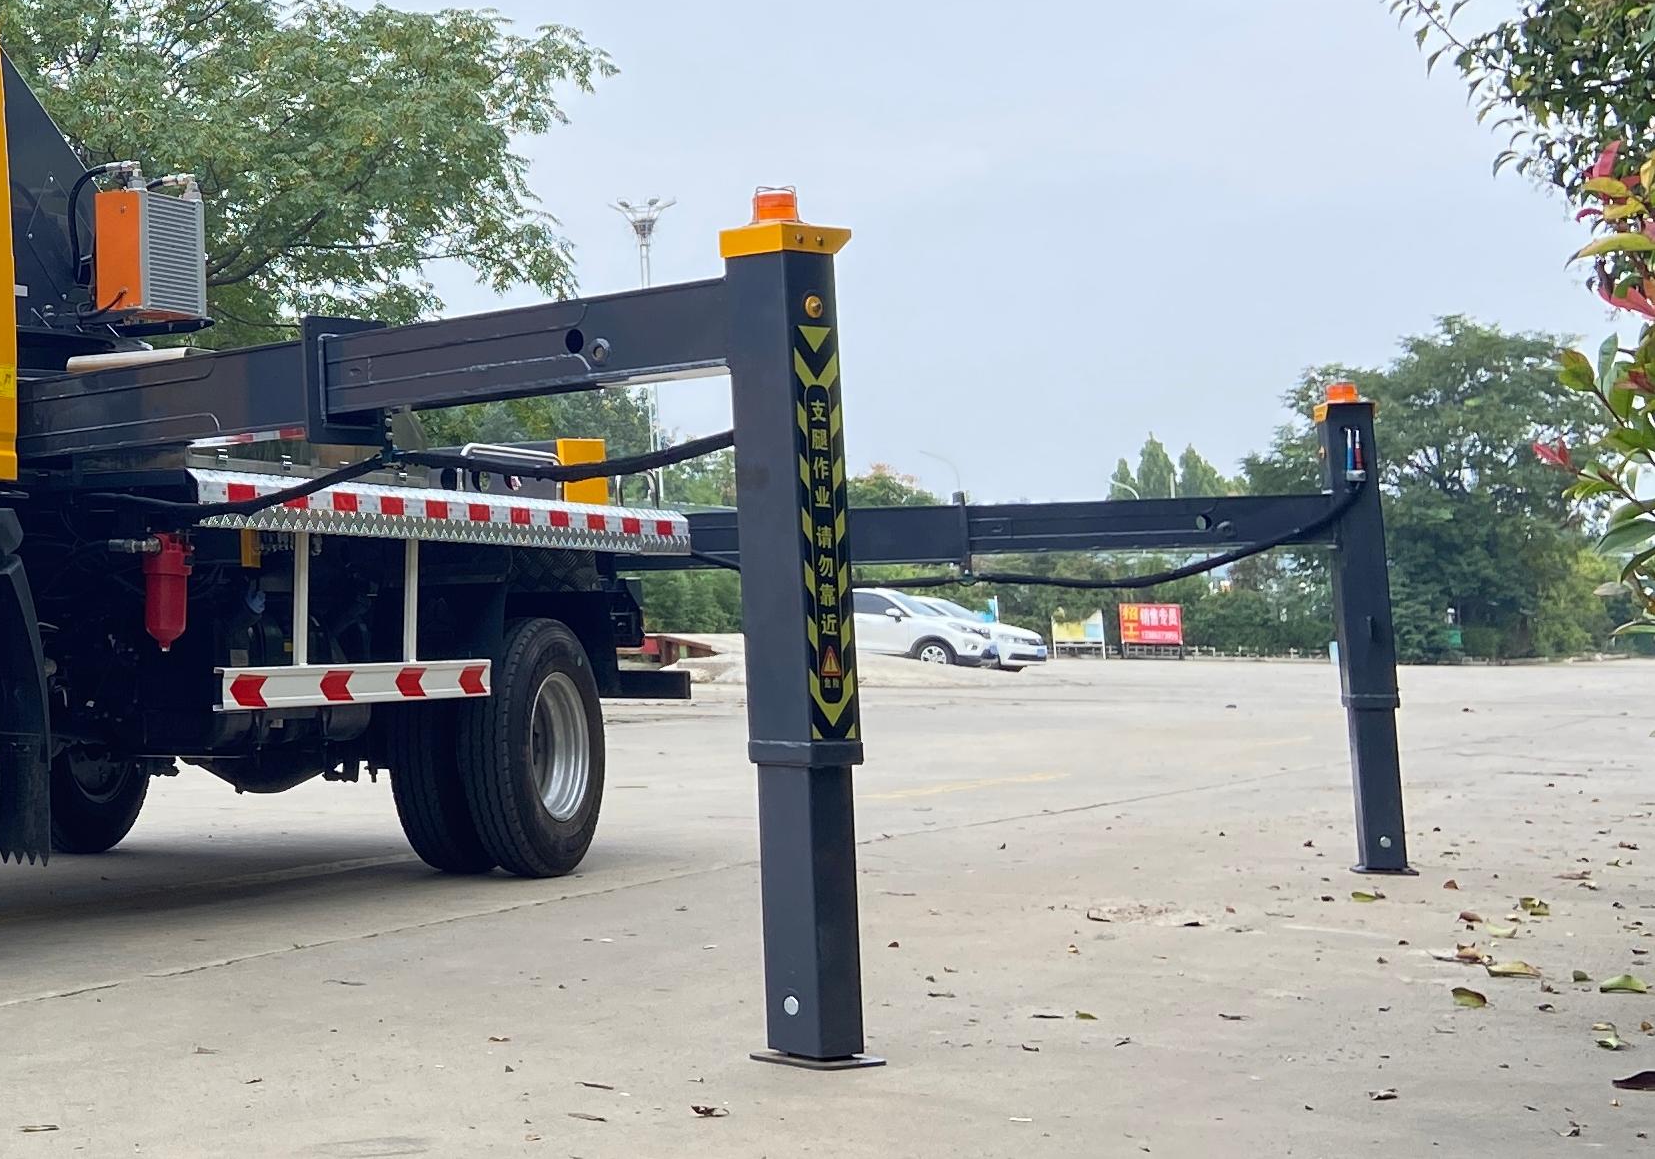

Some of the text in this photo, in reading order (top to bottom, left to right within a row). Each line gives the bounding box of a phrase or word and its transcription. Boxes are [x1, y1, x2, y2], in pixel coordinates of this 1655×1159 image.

[810, 399, 839, 635] 支腿作业 请勿靠近
